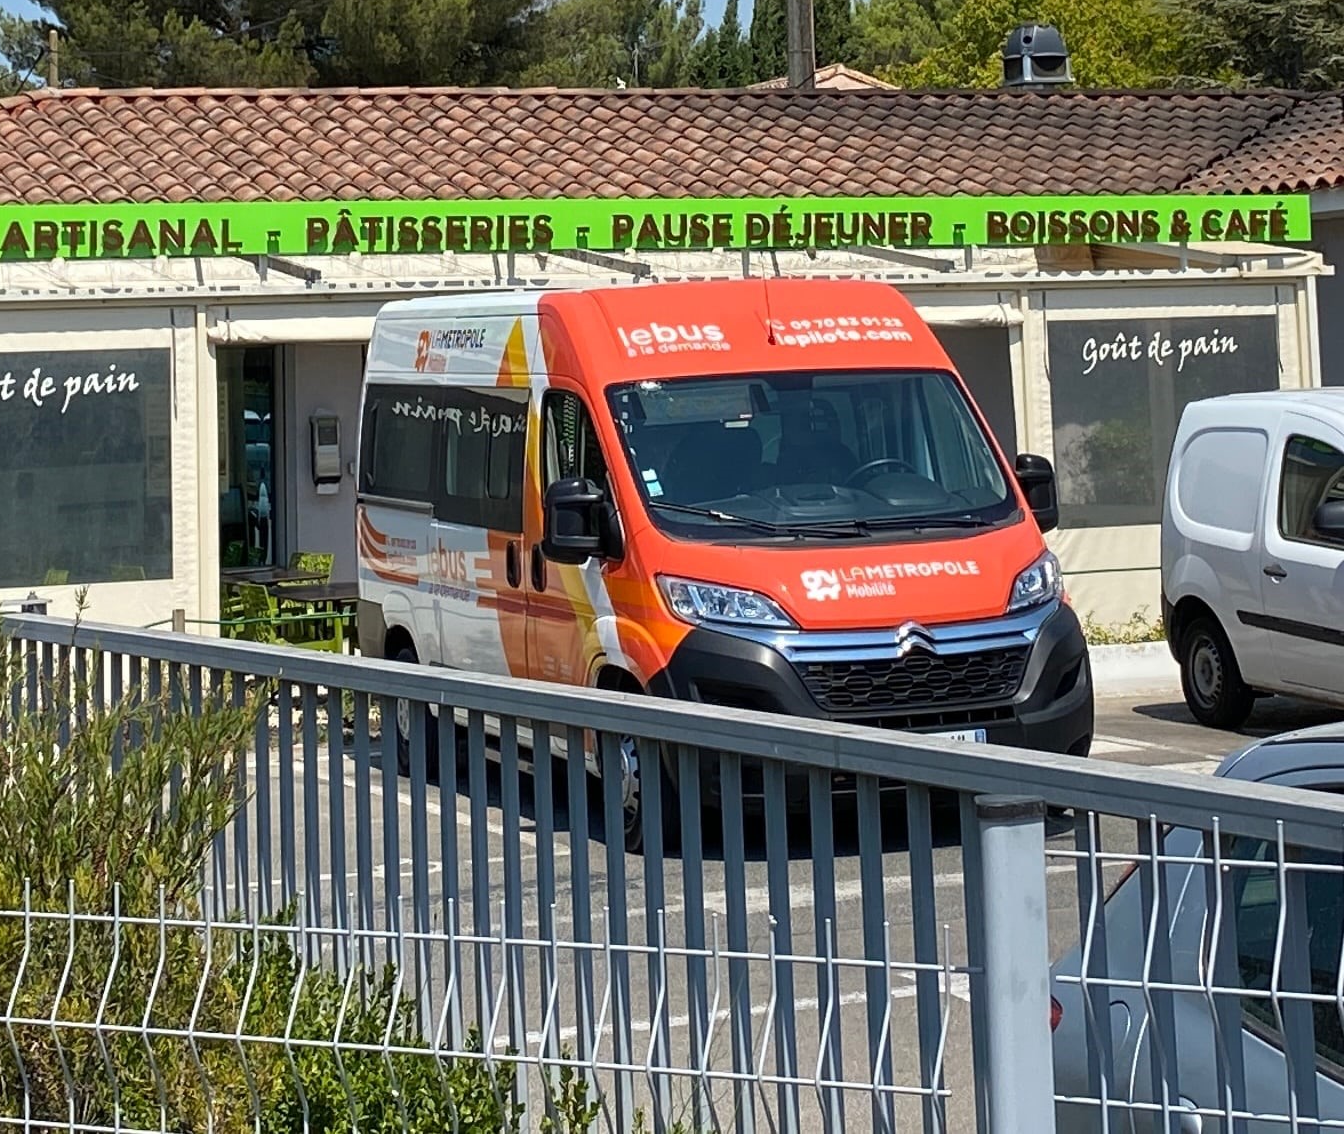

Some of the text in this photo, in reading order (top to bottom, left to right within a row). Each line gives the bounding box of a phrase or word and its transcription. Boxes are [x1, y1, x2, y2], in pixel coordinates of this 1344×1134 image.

[0, 218, 243, 253] ARTISANAL
[307, 208, 554, 249] PÂTISSERIES
[612, 213, 734, 244] PAUSE
[746, 204, 934, 245] DÉJEUNER
[987, 210, 1161, 239] BOISSONS
[1170, 209, 1192, 237] &
[1202, 201, 1290, 237] CAFÉ
[617, 322, 724, 347] lebus
[775, 328, 913, 347] lepilote.com
[658, 342, 731, 354] demande
[1082, 328, 1238, 375] Goût de pain
[23, 367, 56, 407] de
[61, 363, 140, 414] pain
[846, 580, 897, 598] Mobilité
